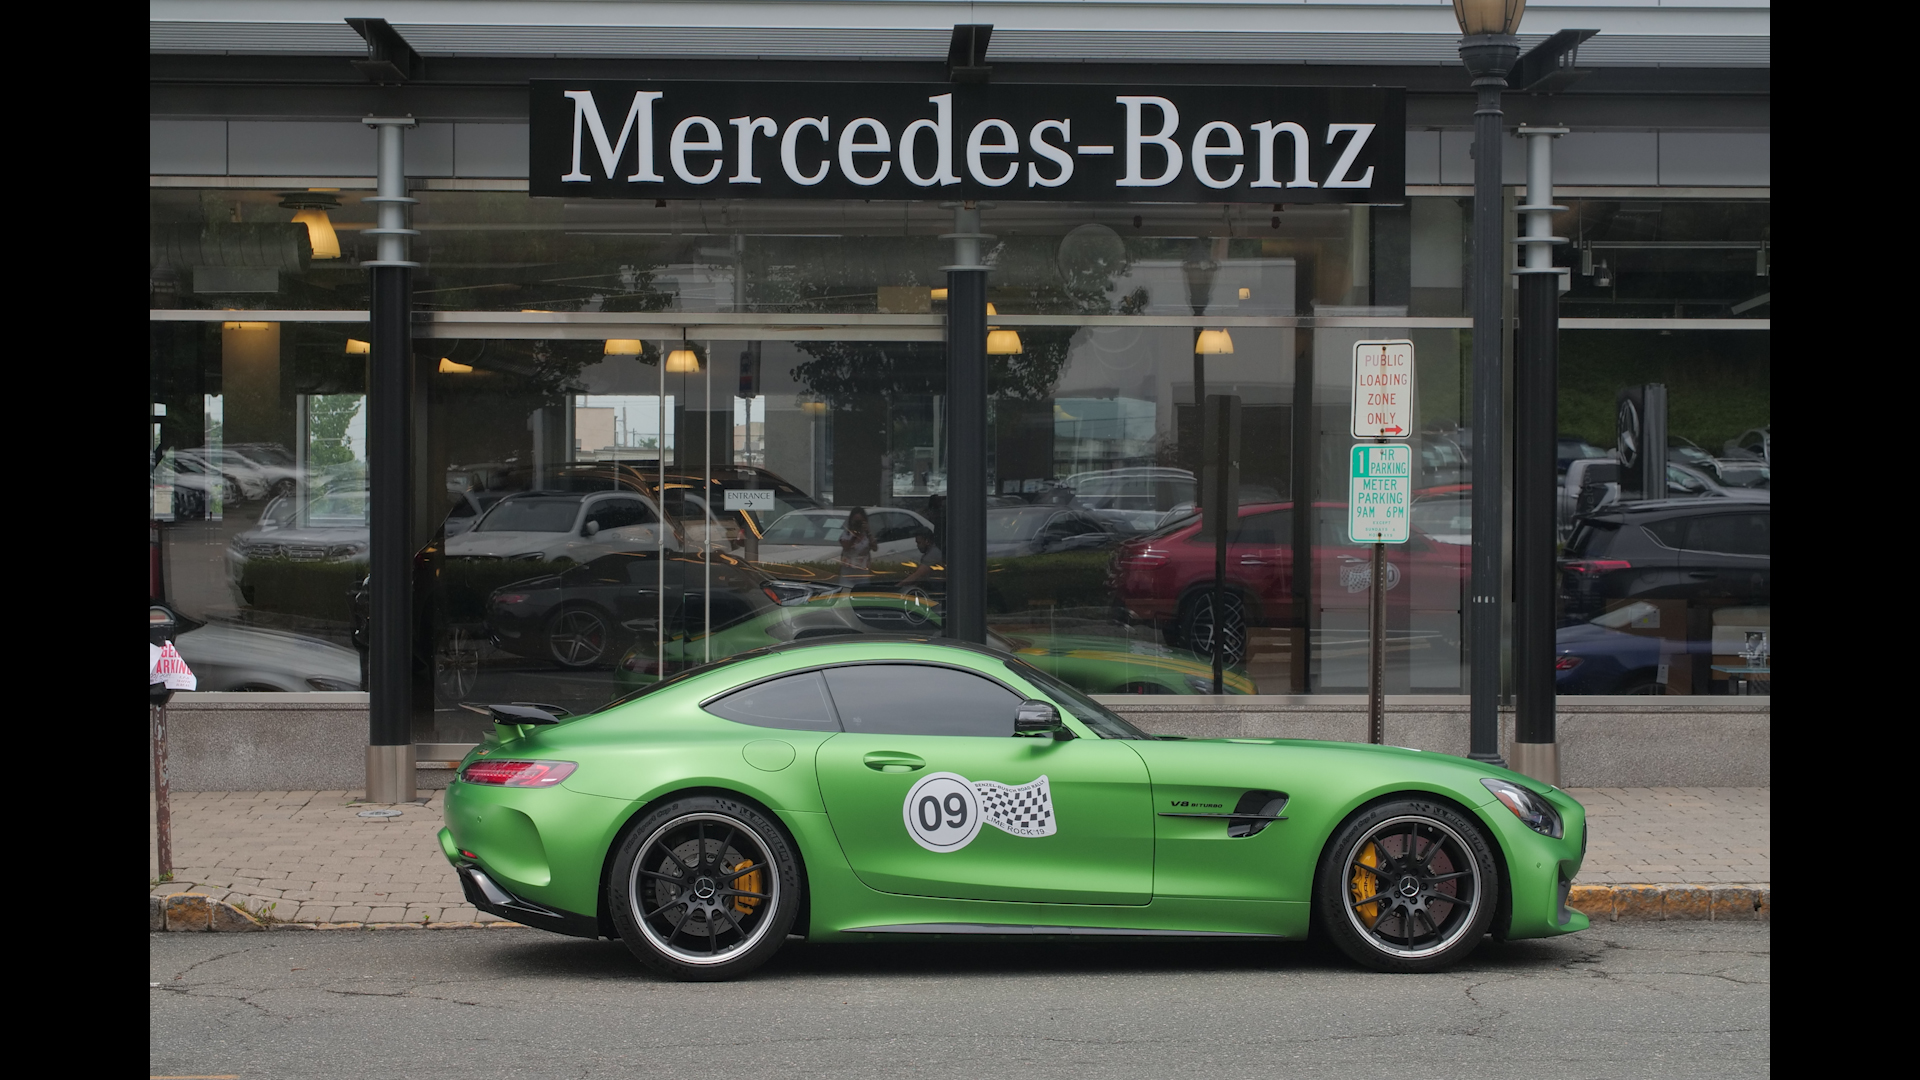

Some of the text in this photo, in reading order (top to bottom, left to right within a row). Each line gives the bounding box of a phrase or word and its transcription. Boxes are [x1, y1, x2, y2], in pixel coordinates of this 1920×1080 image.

[562, 90, 1376, 189] Mercedes-Benz
[1365, 354, 1404, 367] PUBLIC
[1360, 373, 1407, 387] LOADING
[1367, 393, 1396, 405] ZONE
[1367, 412, 1396, 425] ONLY
[1358, 449, 1395, 474] 1 HR
[1370, 462, 1406, 474] PARKING
[1363, 479, 1397, 491] METER
[727, 492, 771, 500] ENTRANCE
[1358, 492, 1403, 504] PARKING
[1356, 506, 1404, 518] 9AM 6PM
[974, 783, 1017, 793] BENZEL-BUSCH
[1031, 779, 1045, 789] RALLY
[918, 792, 968, 832] 09
[986, 815, 1005, 829] LIME
[1007, 825, 1033, 836] ROCK
[1445, 812, 1484, 852] MICHELIN
[752, 815, 789, 861] MICHELIN
